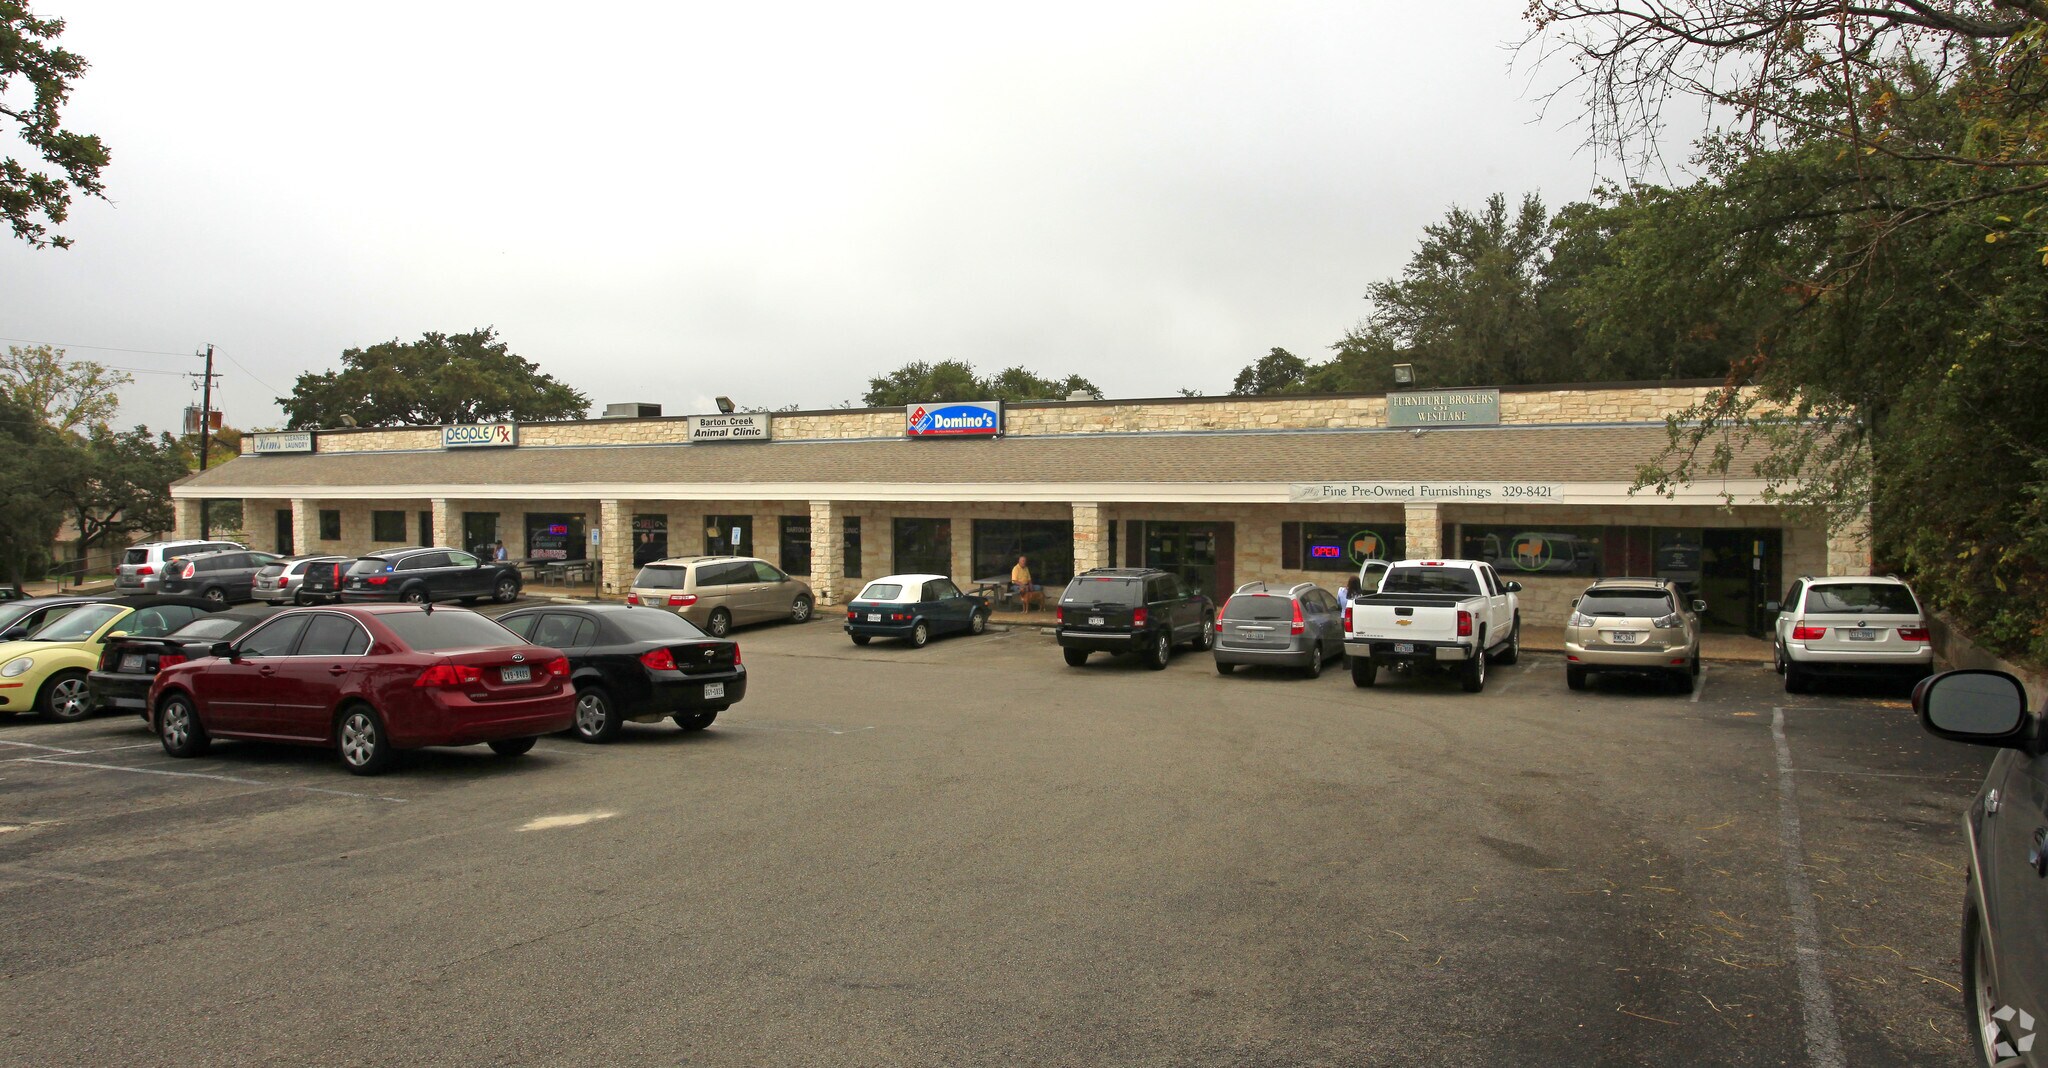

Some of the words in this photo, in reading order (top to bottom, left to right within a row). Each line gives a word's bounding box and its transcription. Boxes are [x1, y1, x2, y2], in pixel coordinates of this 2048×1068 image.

[1393, 396, 1444, 406] FURNITURE
[1449, 394, 1493, 405] BROKERS
[700, 418, 726, 426] Barton
[730, 417, 753, 425] Creek
[934, 412, 993, 428] Domino's
[1418, 411, 1467, 421] WESTLAKE
[694, 428, 728, 437] Animal
[733, 427, 761, 436] Clinic
[1323, 485, 1347, 496] Fine
[1351, 485, 1414, 496] Pre-Owned
[1420, 485, 1492, 499] Furnishings
[1502, 486, 1552, 497] 329-8421
[1313, 546, 1339, 557] OPEN
